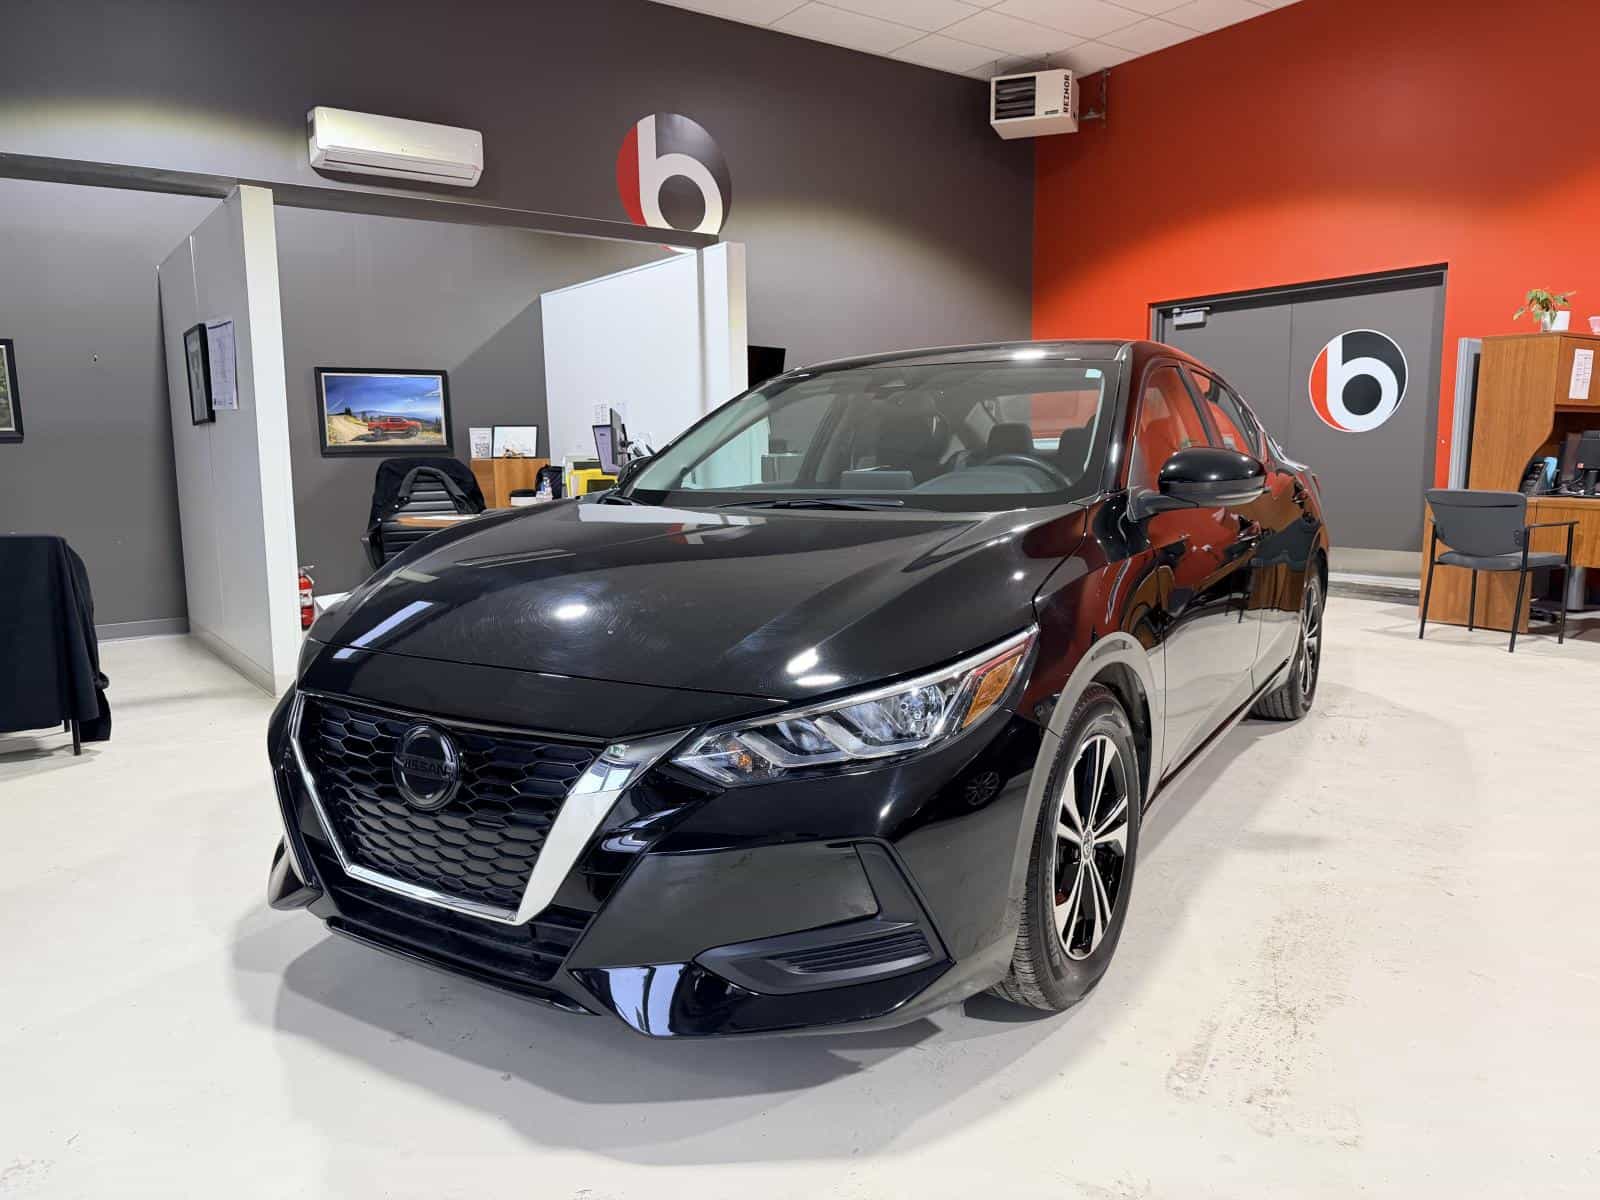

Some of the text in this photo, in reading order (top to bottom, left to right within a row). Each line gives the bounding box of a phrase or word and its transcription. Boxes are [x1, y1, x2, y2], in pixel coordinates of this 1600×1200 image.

[1063, 73, 1071, 113] REZNOR
[637, 113, 723, 246] b
[1327, 332, 1399, 432] b
[403, 758, 447, 778] NISSAN
